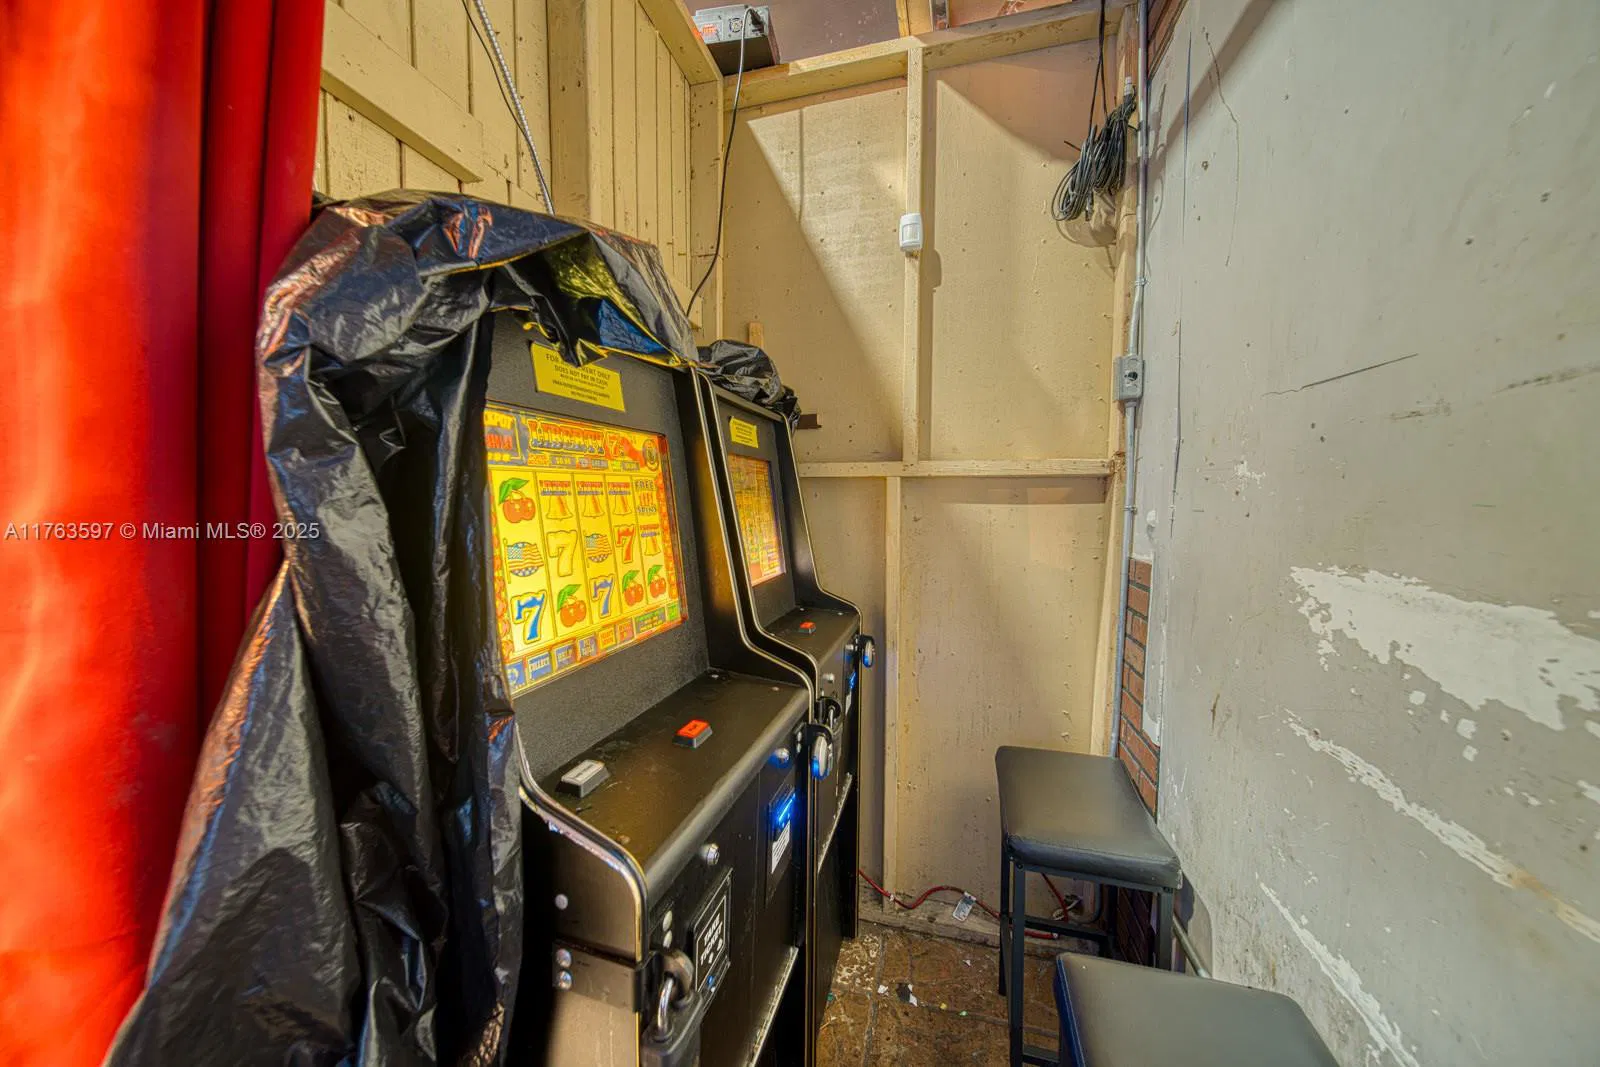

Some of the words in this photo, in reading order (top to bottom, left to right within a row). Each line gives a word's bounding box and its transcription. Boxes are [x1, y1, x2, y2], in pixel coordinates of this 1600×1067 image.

[634, 479, 654, 490] FREE
[546, 529, 578, 577] 7
[613, 524, 635, 564] 7
[510, 589, 547, 645] 7
[589, 574, 616, 619] 7
[700, 921, 723, 966] TICKET
[704, 913, 721, 946] TAKE
